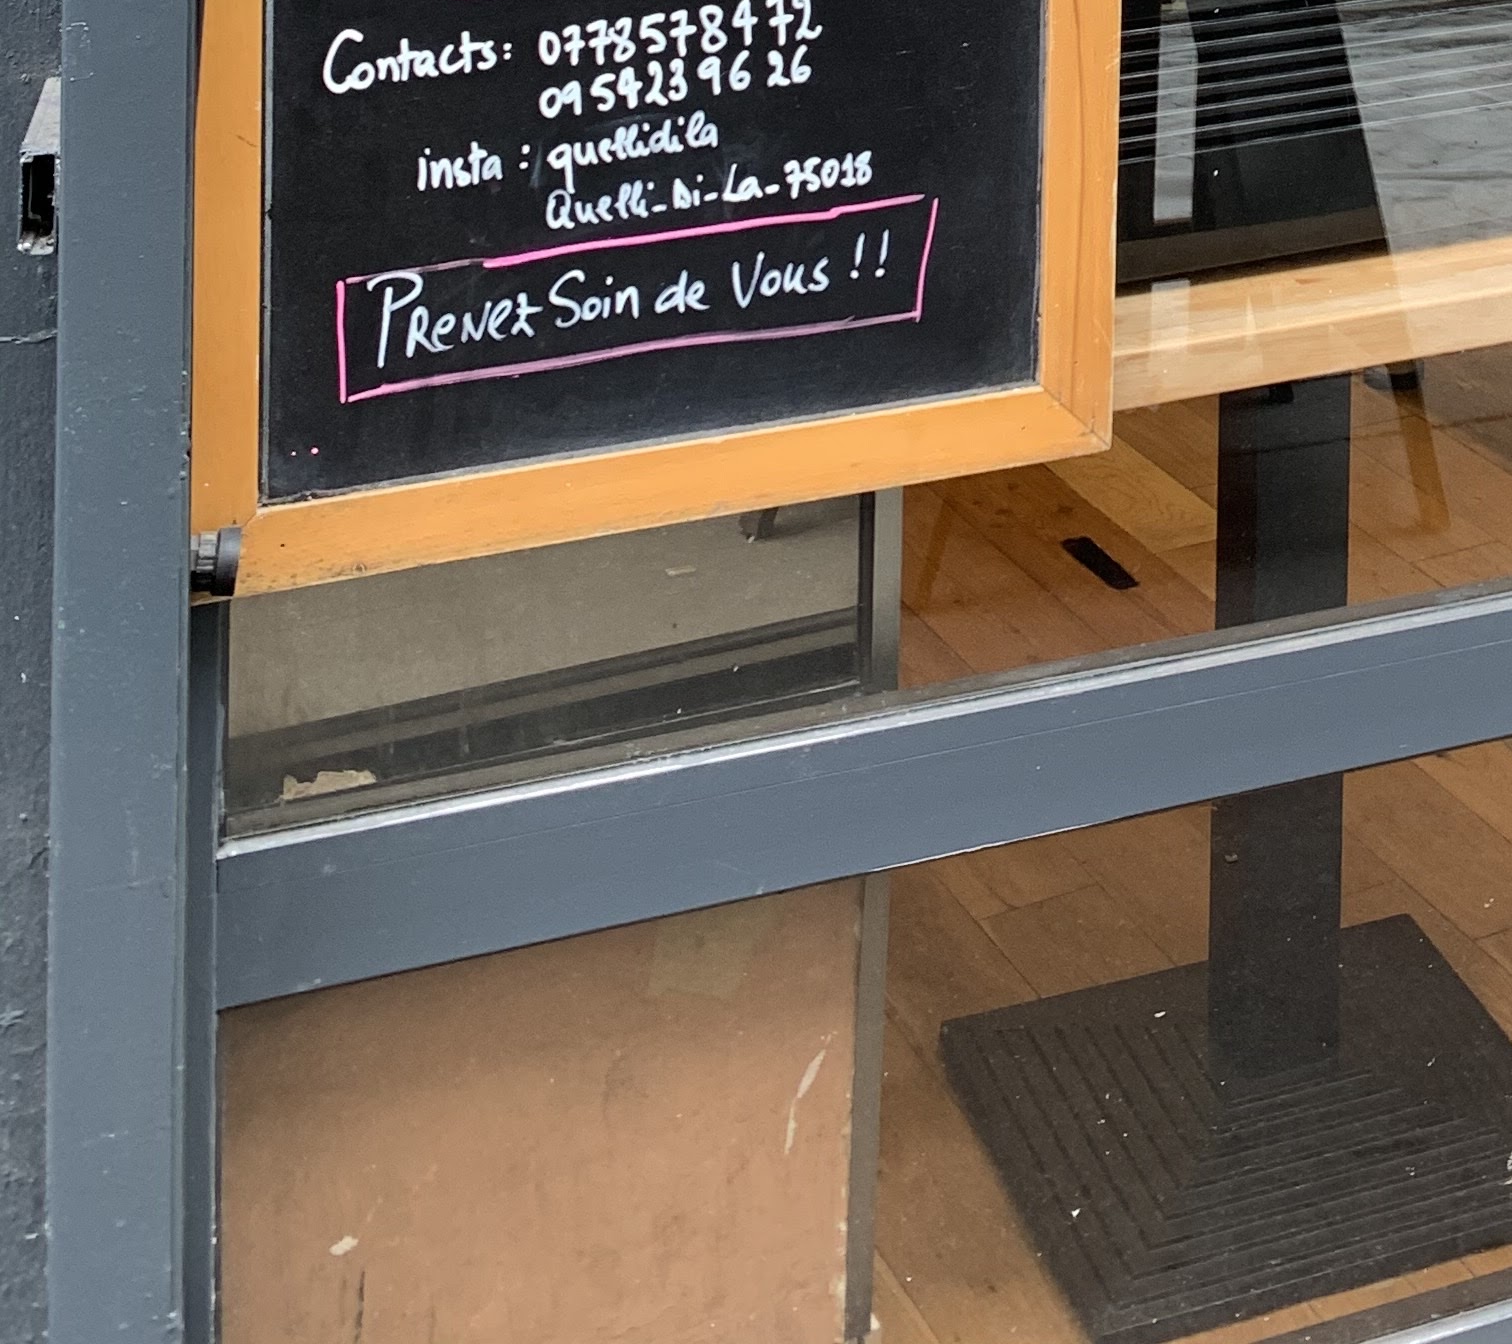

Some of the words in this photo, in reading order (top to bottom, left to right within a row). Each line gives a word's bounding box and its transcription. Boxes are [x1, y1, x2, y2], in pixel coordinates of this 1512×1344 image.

[548, 269, 640, 328] Soin
[654, 270, 710, 314] de
[731, 251, 830, 309] Vous
